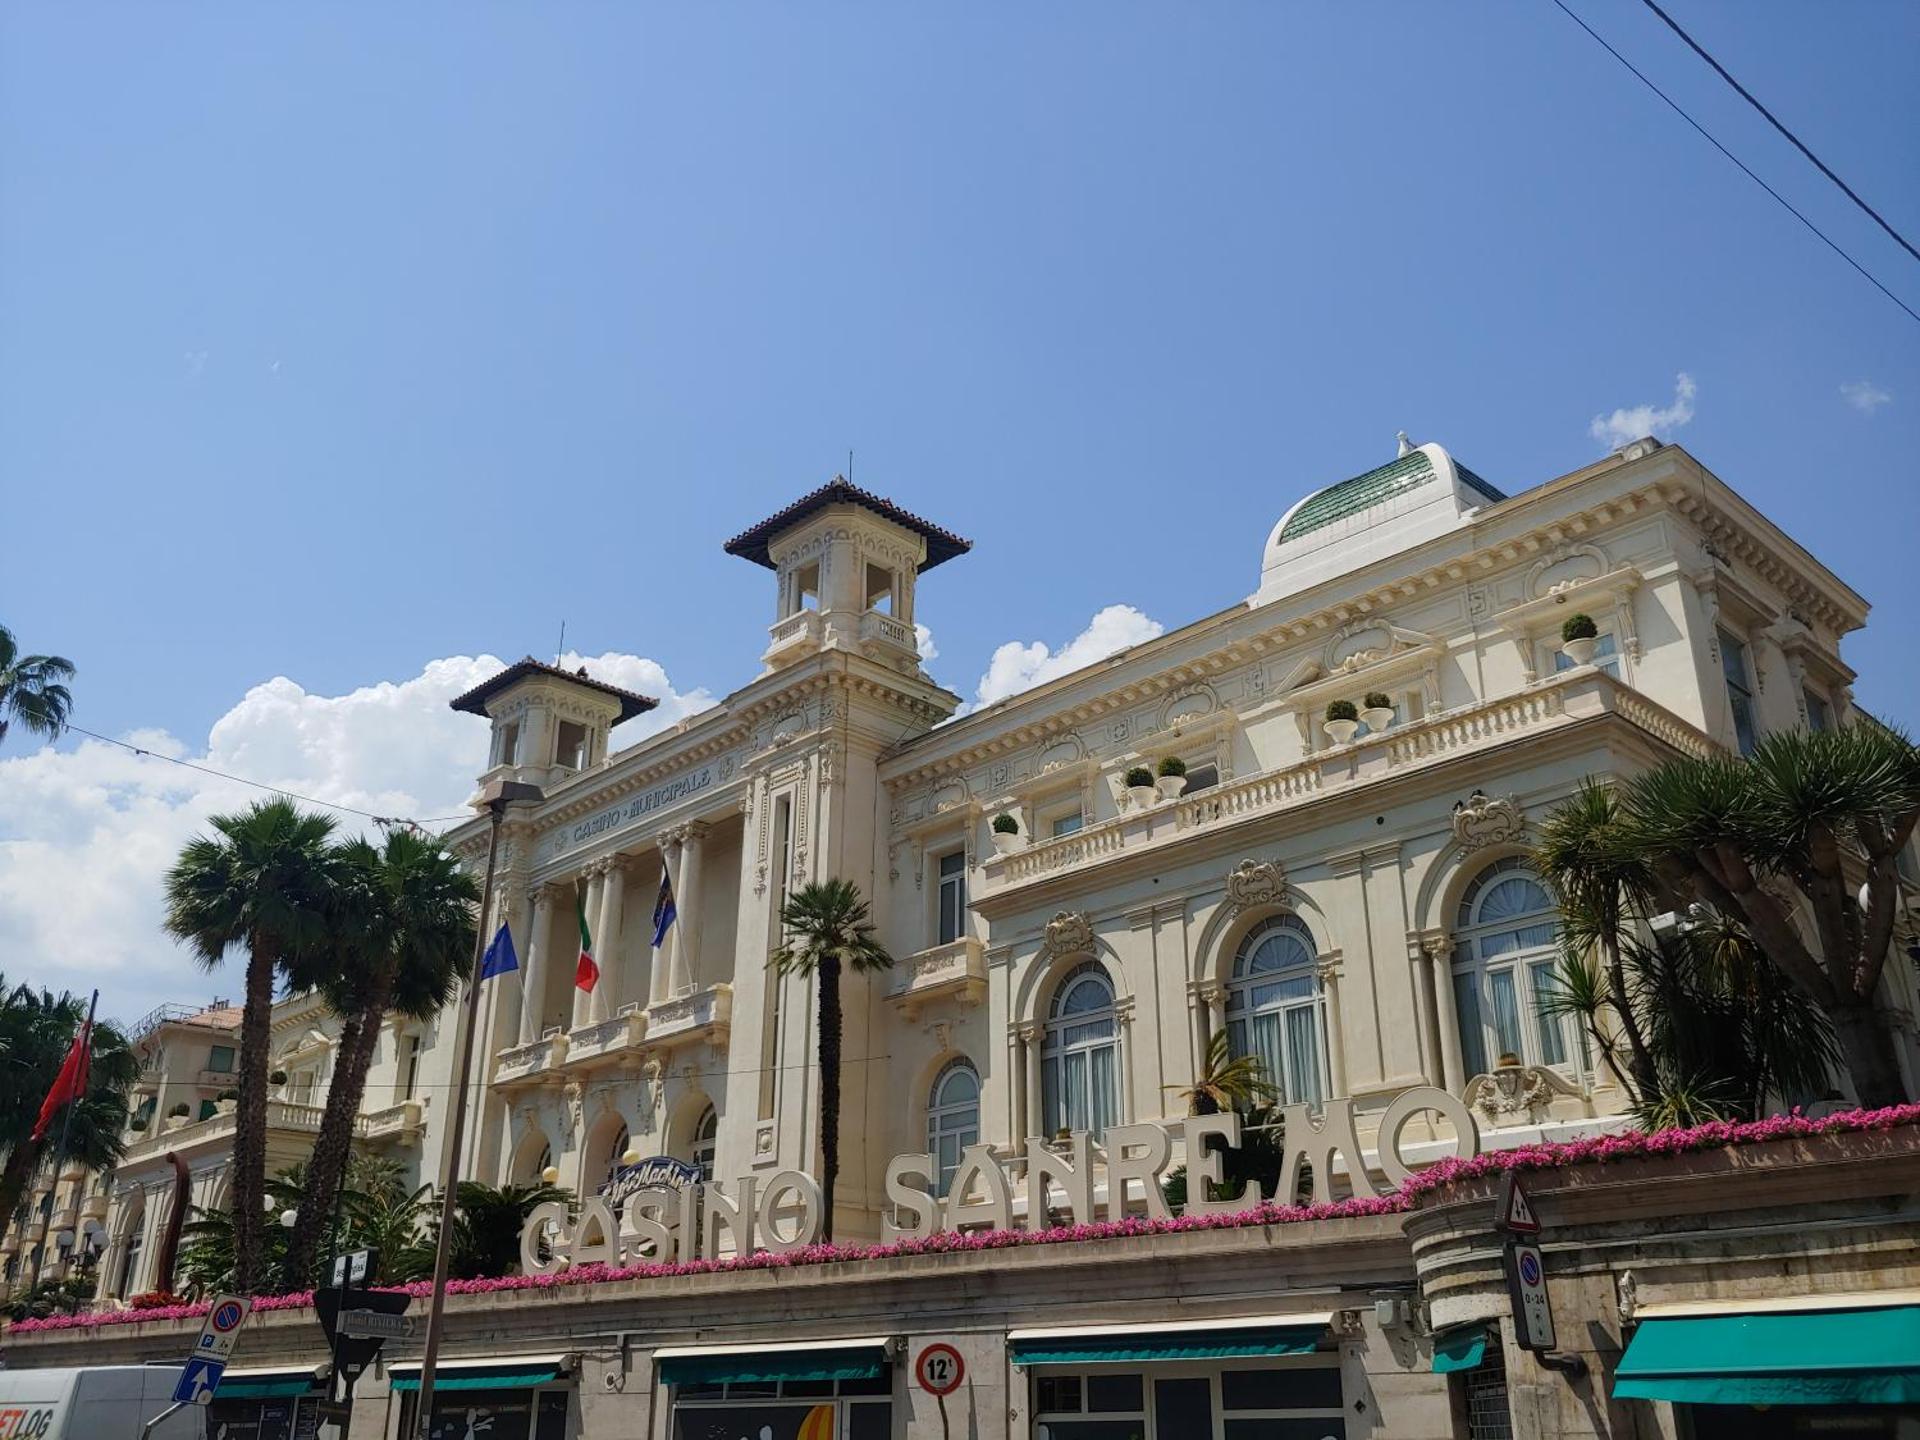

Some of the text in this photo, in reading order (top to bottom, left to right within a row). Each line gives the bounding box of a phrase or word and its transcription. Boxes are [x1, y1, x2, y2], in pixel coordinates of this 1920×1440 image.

[574, 769, 712, 842] CASINO MUNICIPALE
[519, 1086, 1480, 1277] CASINO SANREMO
